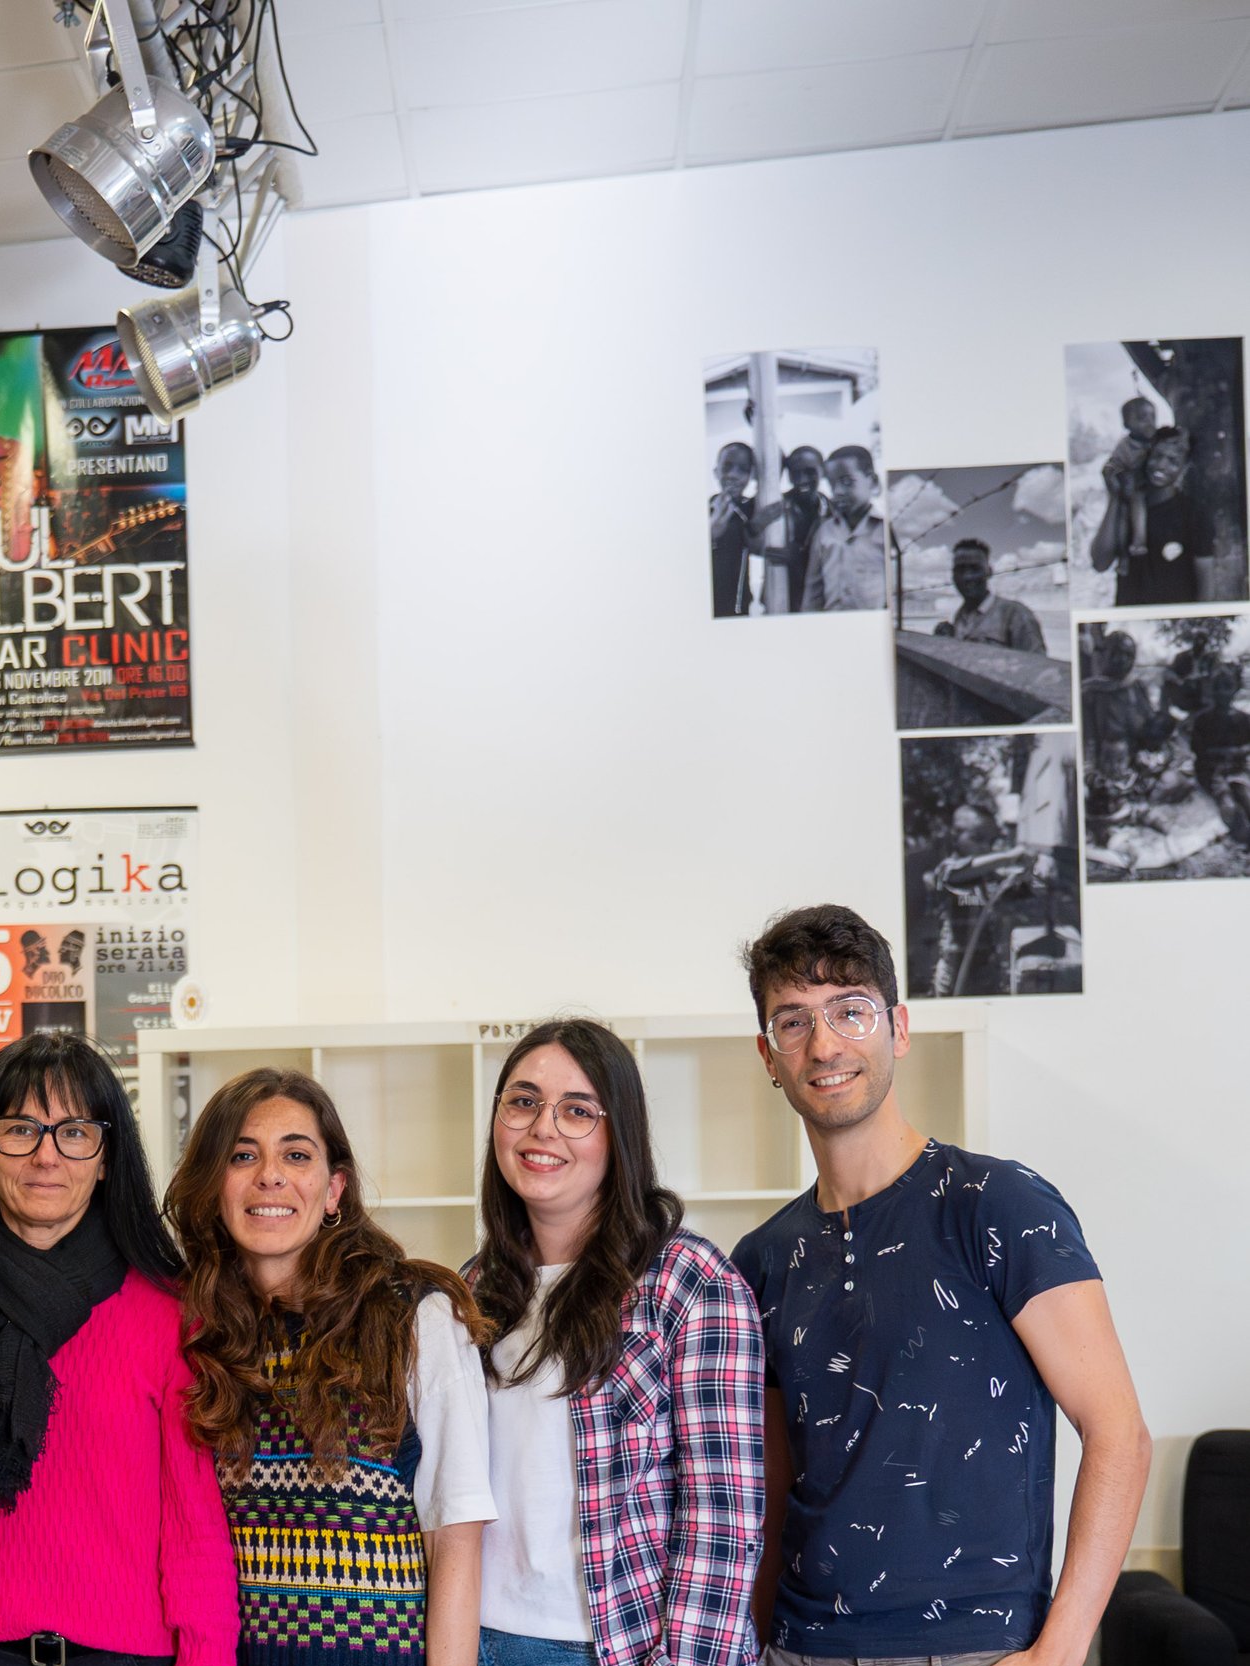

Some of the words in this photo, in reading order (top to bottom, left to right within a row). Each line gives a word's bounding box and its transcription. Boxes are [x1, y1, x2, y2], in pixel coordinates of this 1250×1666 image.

[69, 395, 147, 411] COLLABORAZION
[66, 453, 169, 477] PRESENTANO
[62, 629, 189, 668] CLINIC
[4, 668, 81, 690] NOVEMBRE
[83, 667, 113, 687] 2011
[115, 666, 143, 685] ORE
[8, 690, 69, 706] Cattolica
[95, 926, 185, 944] inizio
[96, 944, 185, 961] serata
[97, 963, 126, 974] ore
